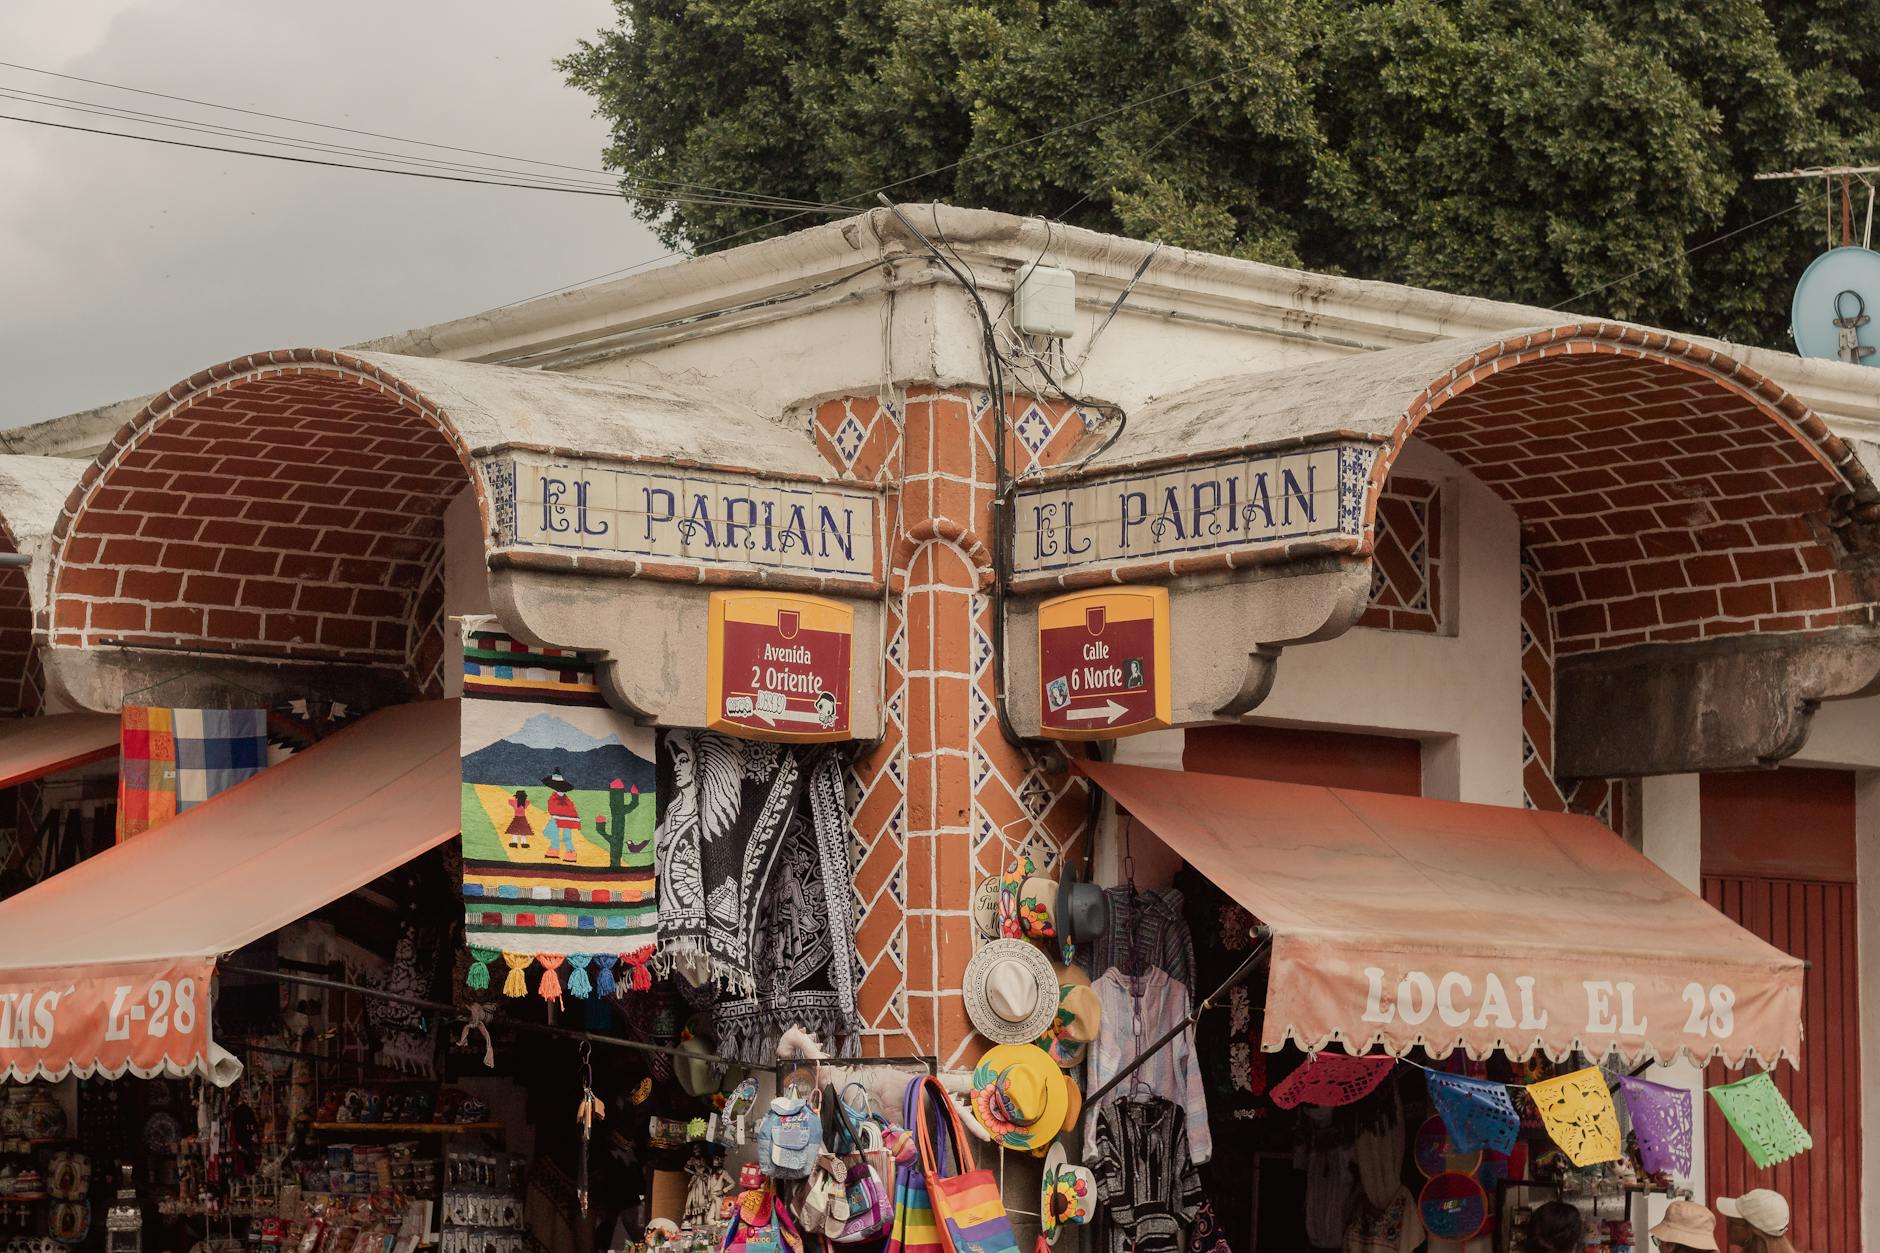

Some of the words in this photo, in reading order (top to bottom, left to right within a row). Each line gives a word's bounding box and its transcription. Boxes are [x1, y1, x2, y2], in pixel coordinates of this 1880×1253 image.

[540, 476, 608, 536] EL
[642, 486, 855, 561] PARIAN
[1033, 501, 1091, 560] EL
[1118, 465, 1317, 549] PARIAN
[764, 643, 811, 665] Avenida
[1083, 641, 1109, 661] Calle
[751, 666, 761, 688] 2
[766, 667, 823, 694] Oriente
[1071, 668, 1080, 690] 6
[1084, 665, 1122, 689] Norte
[105, 978, 195, 1041] L-28
[1361, 967, 1548, 1031] LOCAL
[1583, 980, 1648, 1036] EL
[1682, 982, 1736, 1039] 28
